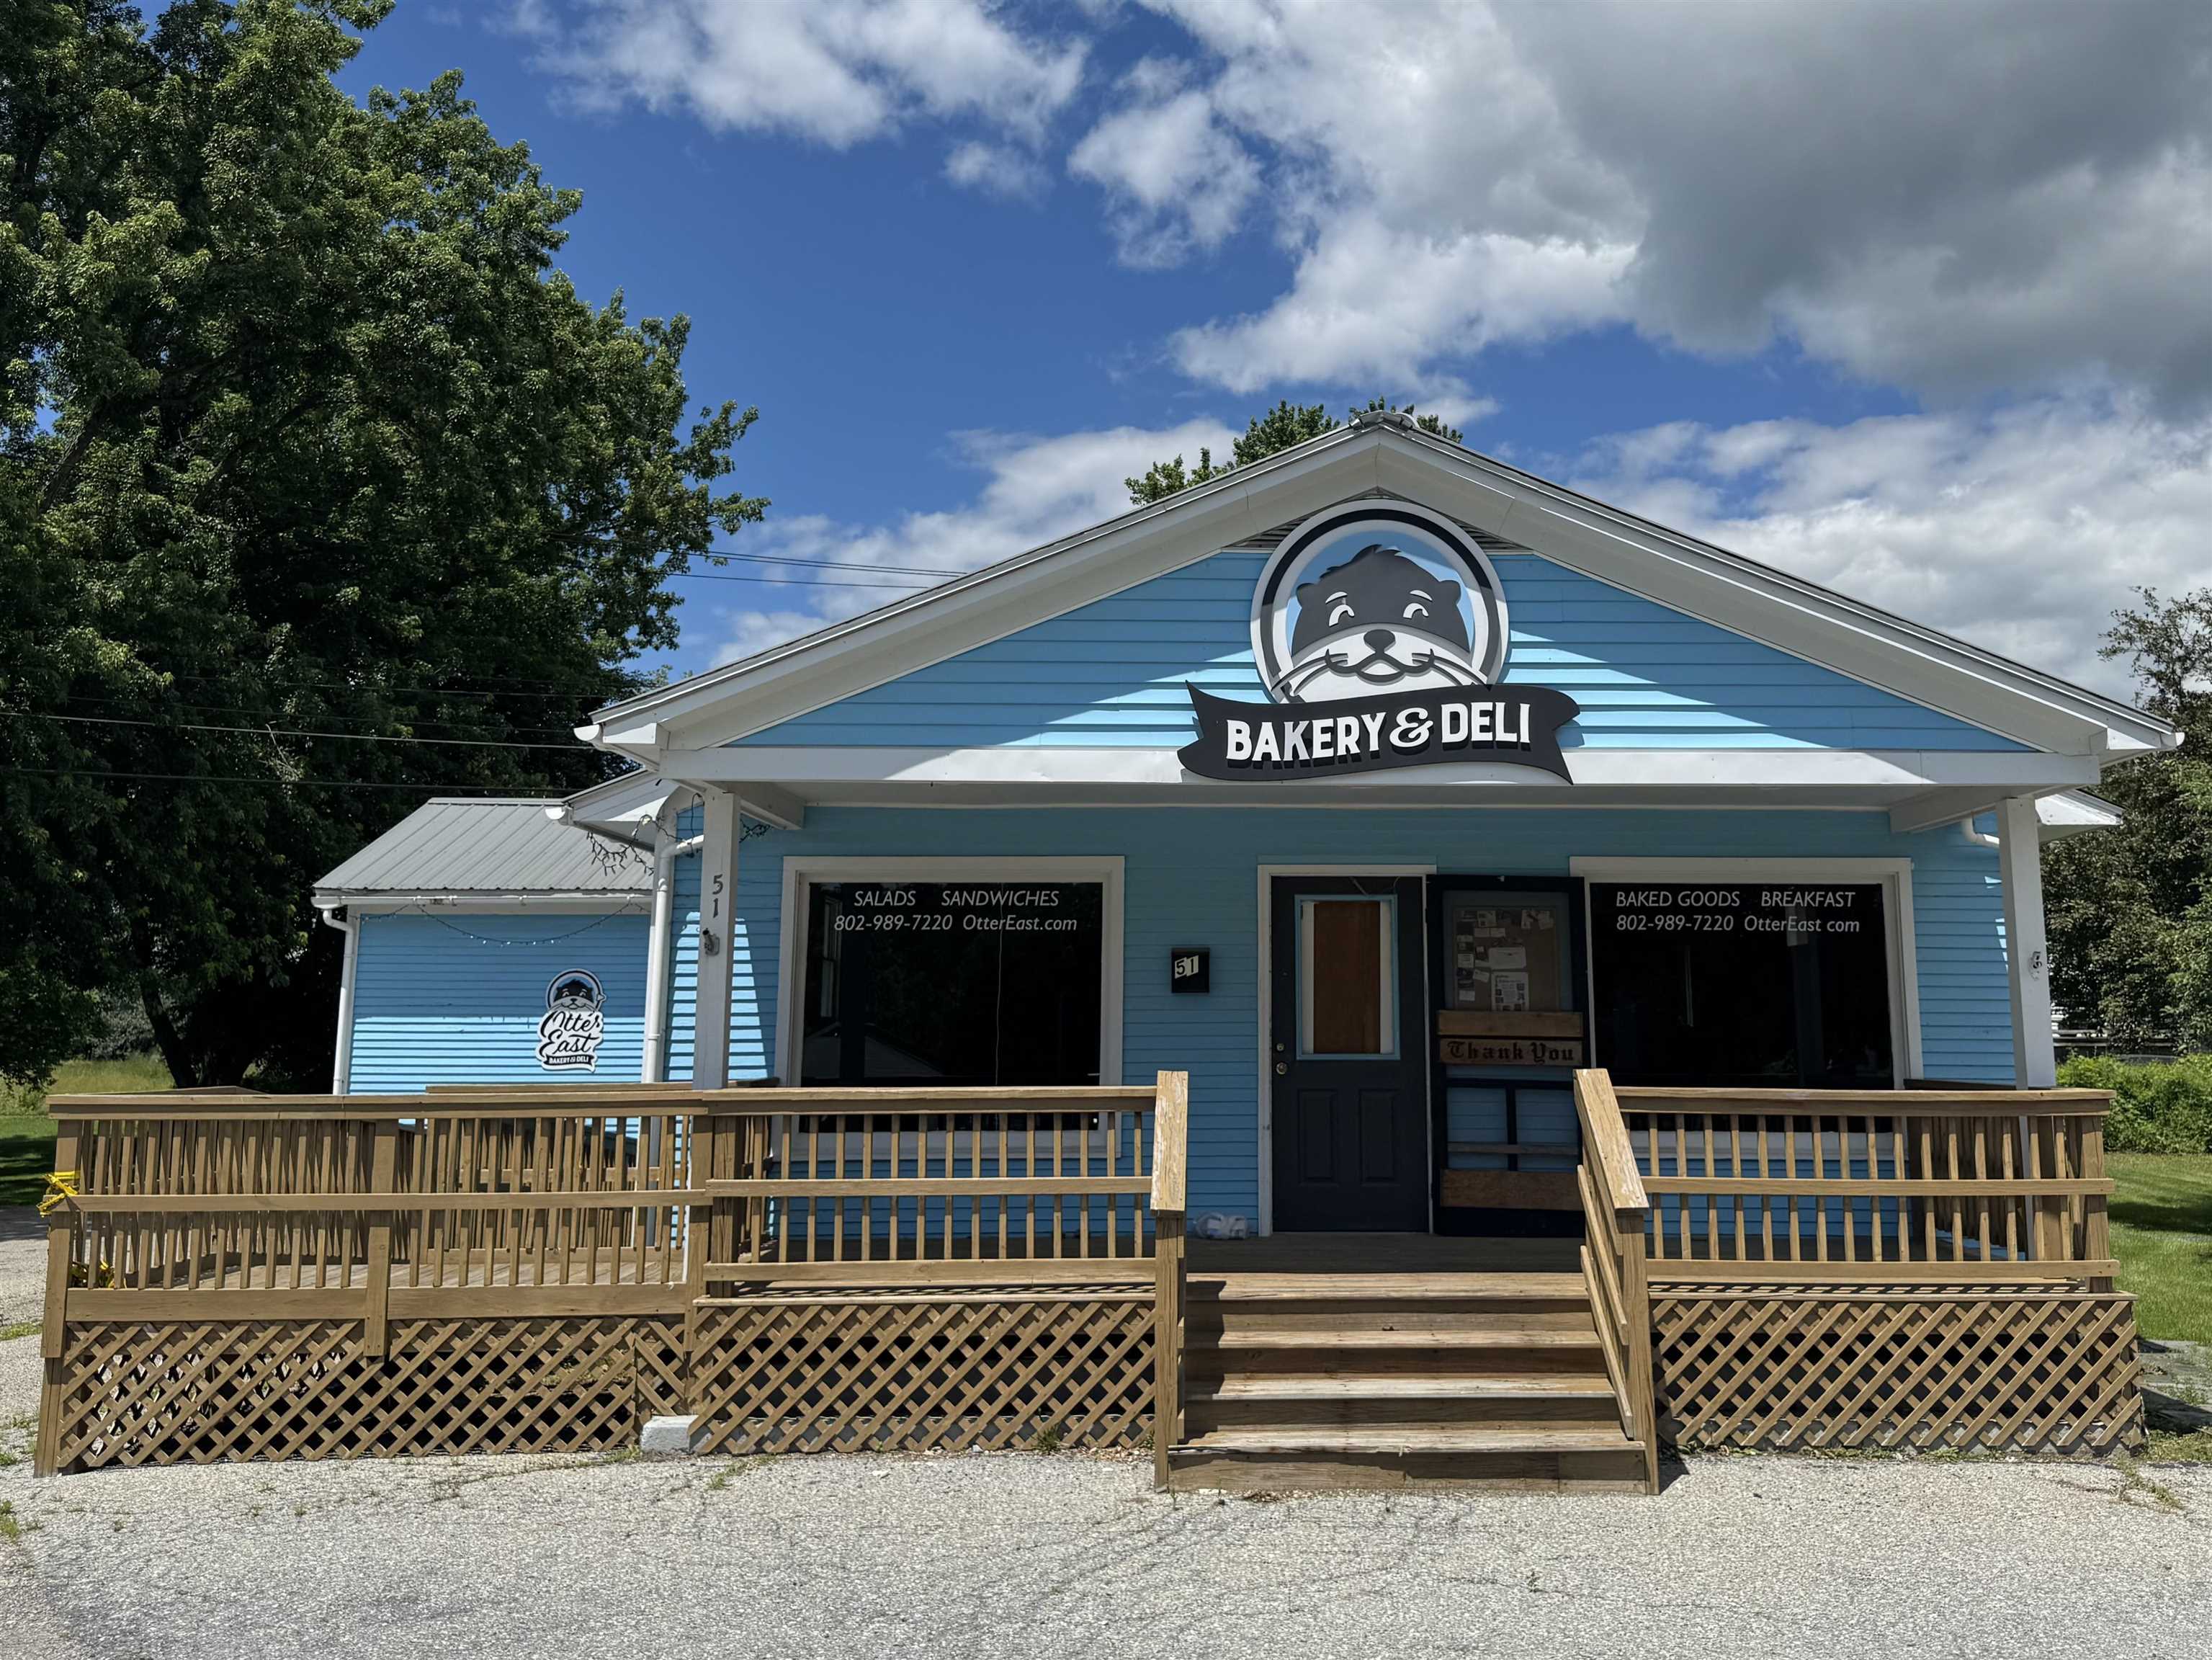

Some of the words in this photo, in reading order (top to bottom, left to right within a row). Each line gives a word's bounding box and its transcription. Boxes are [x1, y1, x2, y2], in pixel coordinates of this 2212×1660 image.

[1226, 712, 1387, 762] BAKERY
[1389, 707, 1434, 748] &
[1441, 702, 1531, 744] DELI
[854, 891, 916, 906] SALADS
[941, 891, 1060, 906] SANDWICHES
[1616, 891, 1672, 906] BAKED
[1678, 891, 1740, 906] GOODS
[1761, 891, 1856, 907] BREAKFAST
[834, 914, 953, 931] 802-989-7220
[962, 914, 1078, 931] OtterEast.com
[1616, 915, 1734, 931] 802-989-7220
[1176, 958, 1194, 975] 51
[539, 1029, 600, 1058] East
[1448, 1040, 1524, 1060] Thank
[1531, 1042, 1574, 1064] You
